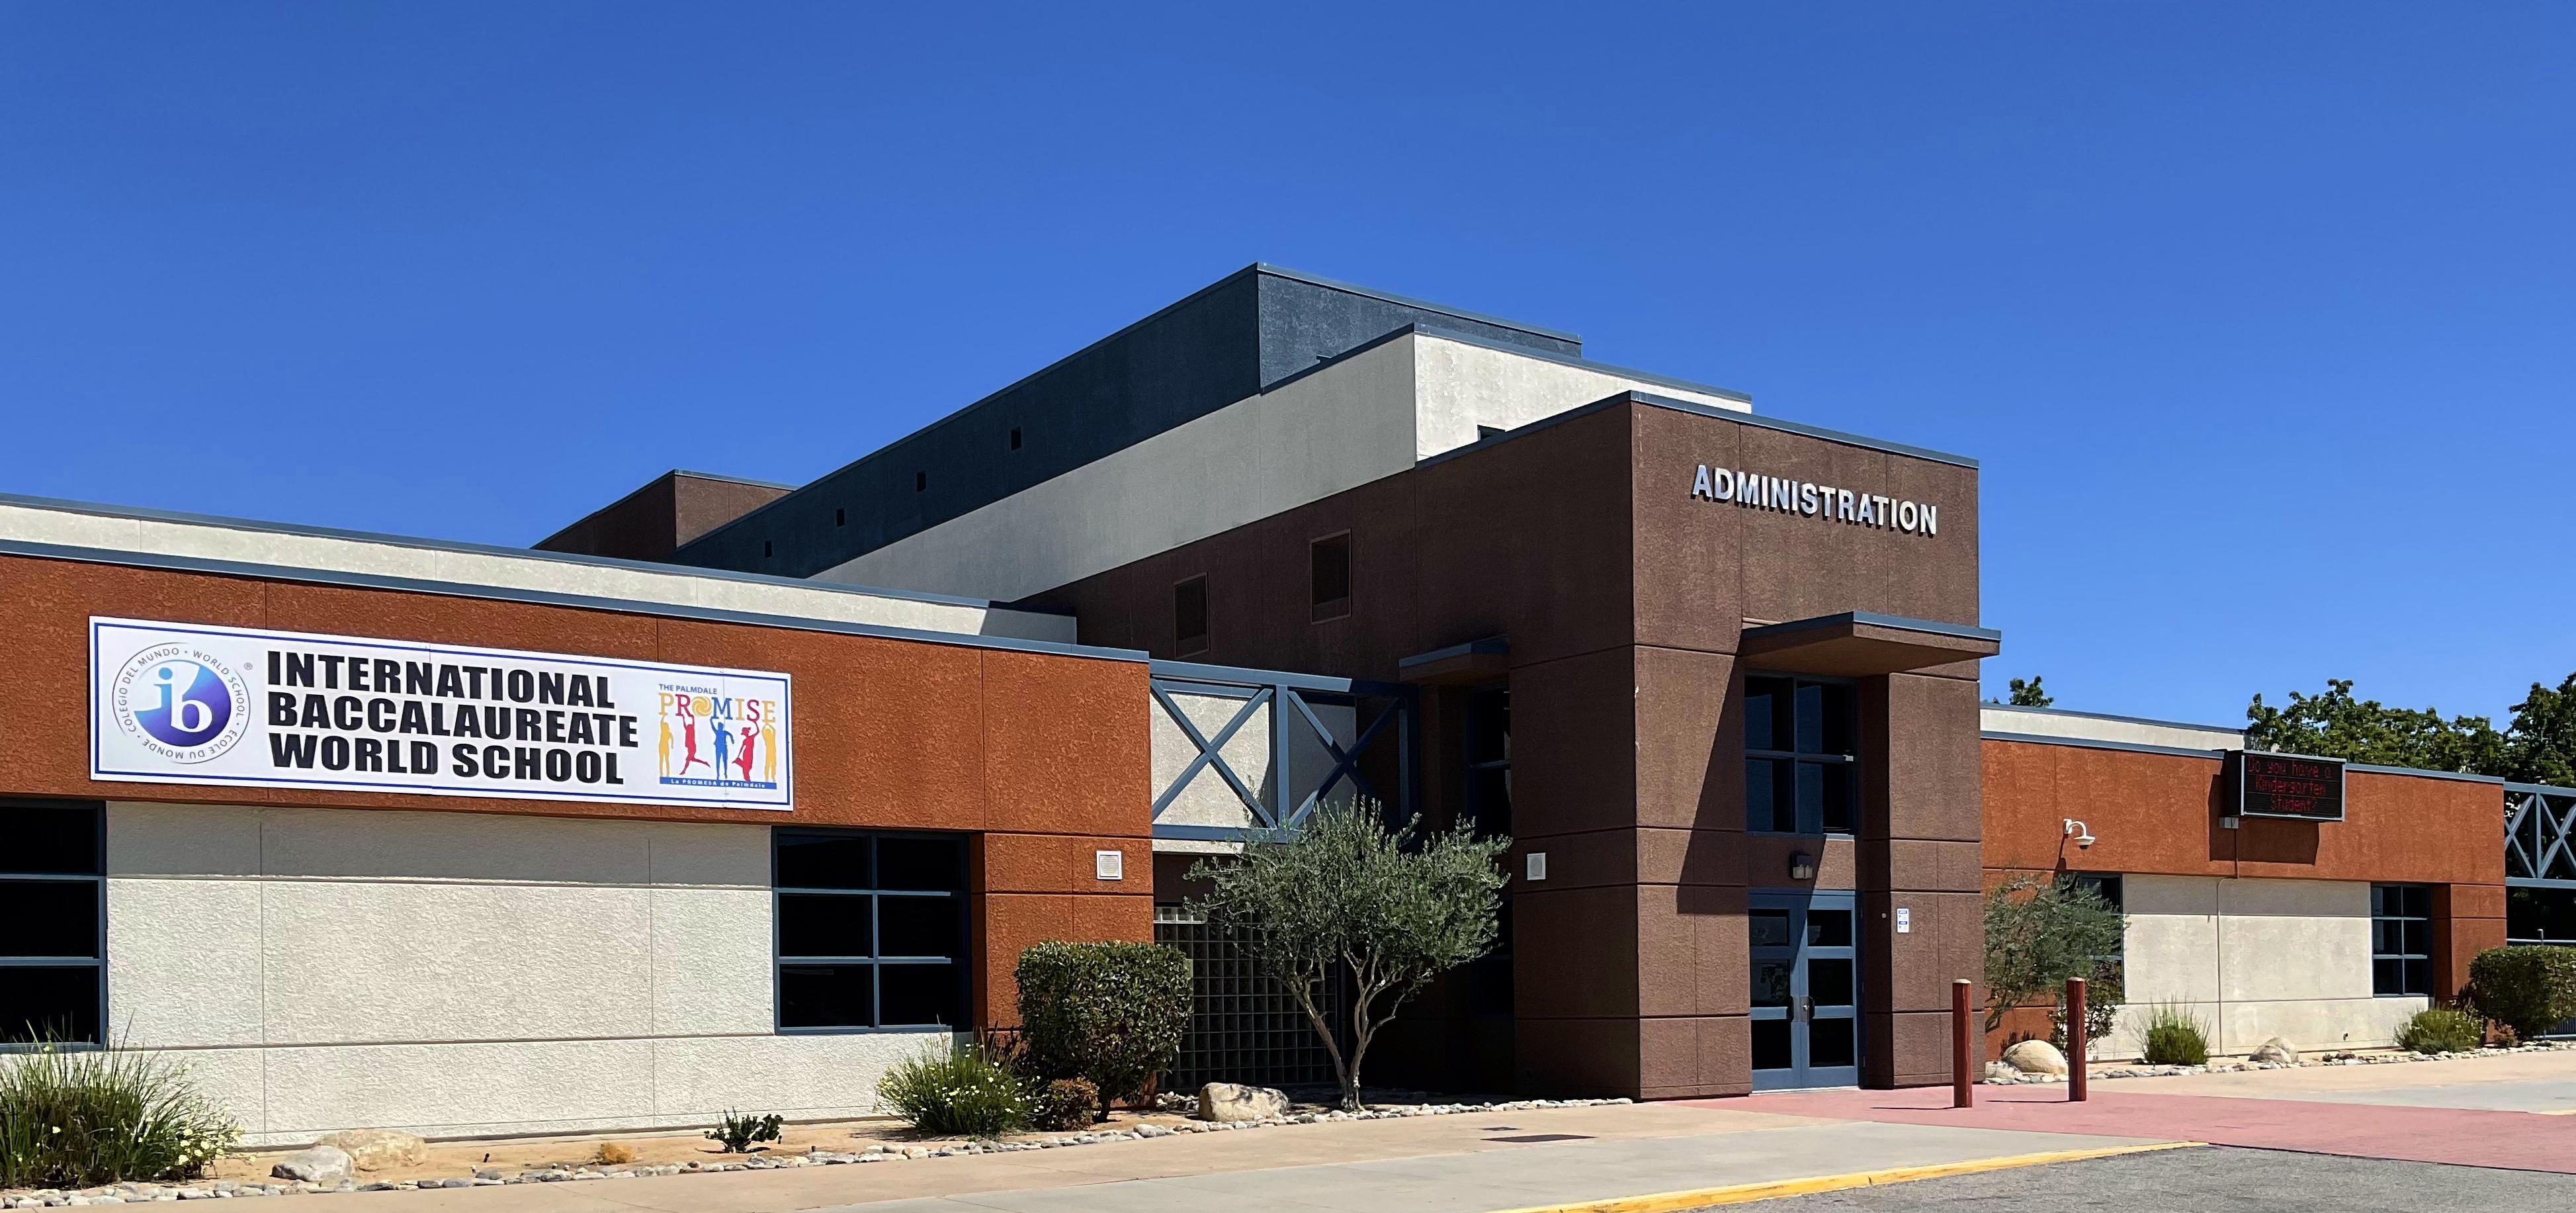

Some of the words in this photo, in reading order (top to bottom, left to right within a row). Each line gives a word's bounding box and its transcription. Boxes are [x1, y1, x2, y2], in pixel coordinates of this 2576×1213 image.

[1692, 465, 1937, 535] ADMINISTRATION
[122, 667, 139, 684] DEL
[138, 648, 179, 666] MUNDO
[193, 649, 229, 675] WORLD
[228, 676, 245, 717] SCHOOL
[267, 651, 615, 709] INTERNATIONAL
[676, 685, 717, 694] PALMDALE
[118, 687, 136, 733] COLEGIO
[268, 692, 638, 747] BACCALAUREATE
[658, 692, 776, 723] PROMISE
[142, 739, 184, 760] MONDE
[269, 733, 439, 775] WORLD
[452, 744, 624, 785] SCHOOL
[2268, 761, 2286, 774] you
[2292, 761, 2319, 778] have
